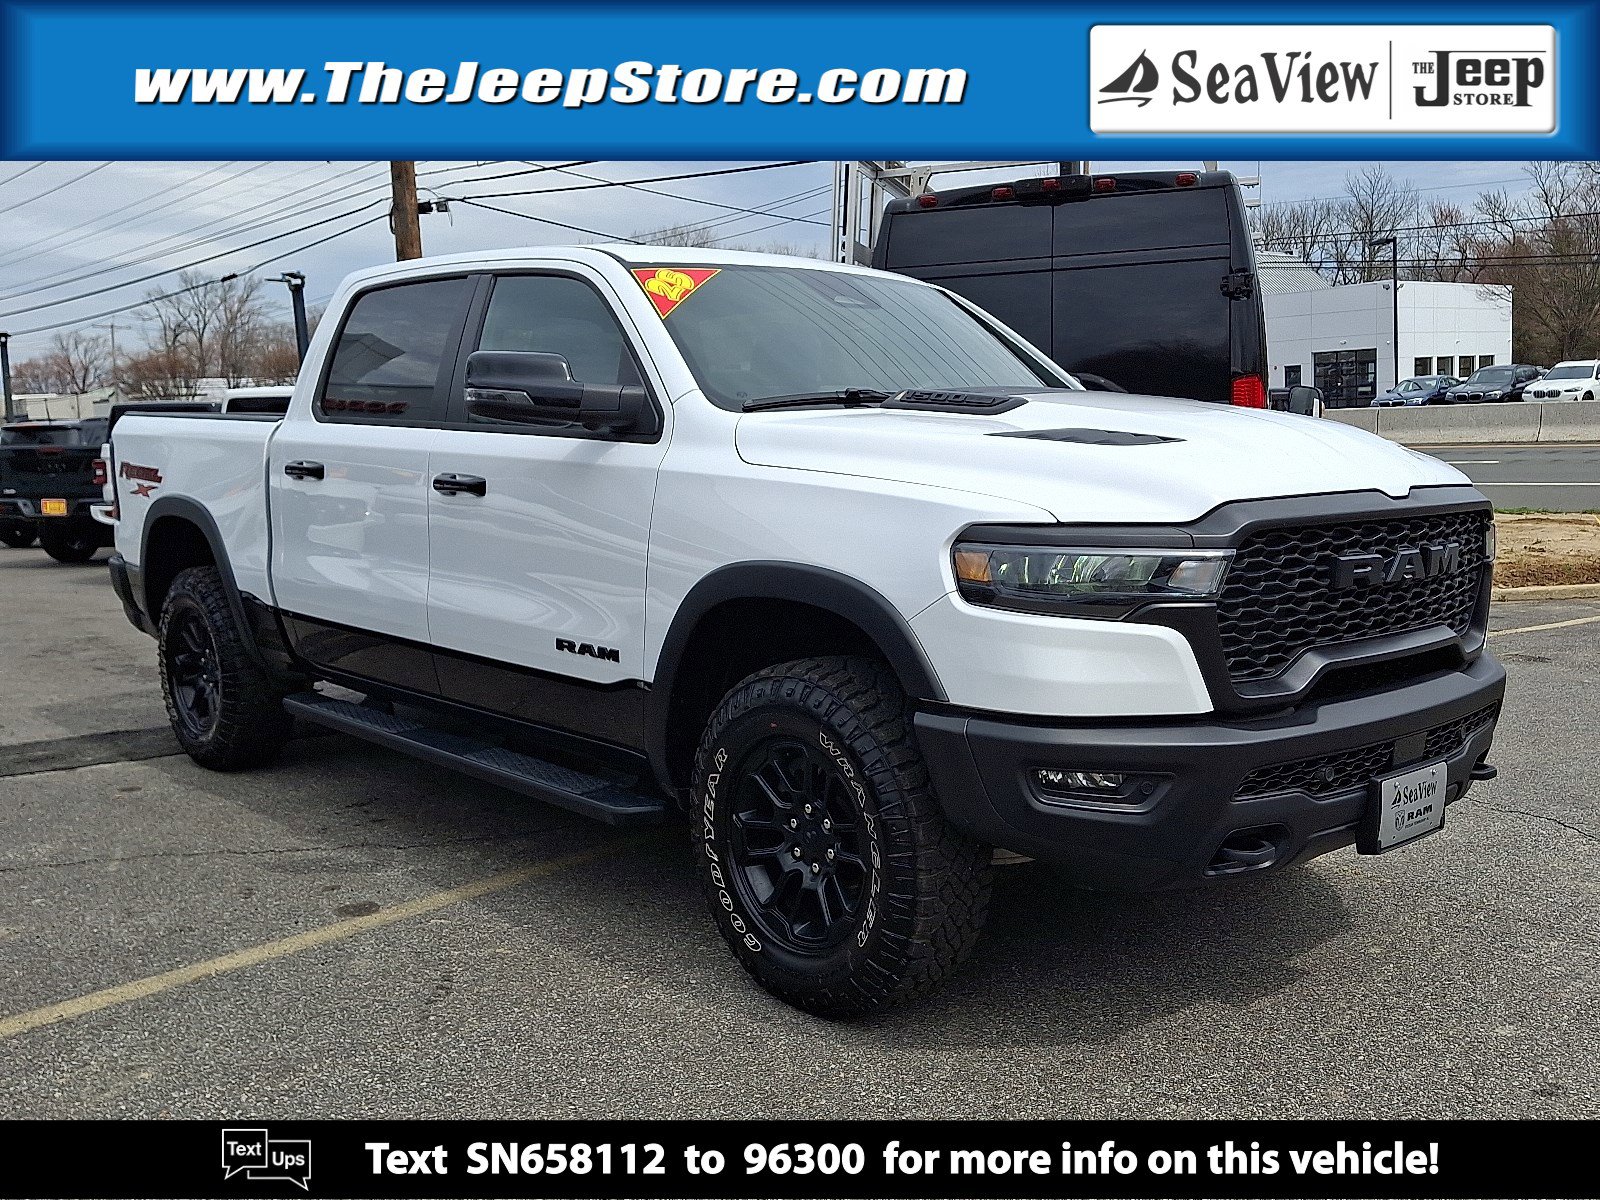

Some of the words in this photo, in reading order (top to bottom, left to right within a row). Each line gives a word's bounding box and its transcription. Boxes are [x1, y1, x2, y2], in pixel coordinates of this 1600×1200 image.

[905, 390, 968, 402] 1500
[1336, 542, 1460, 588] RAM
[555, 637, 620, 664] RAM
[1407, 804, 1433, 822] RAM
[703, 747, 762, 952] GOODYEAR
[819, 731, 881, 948] WRANGLER
